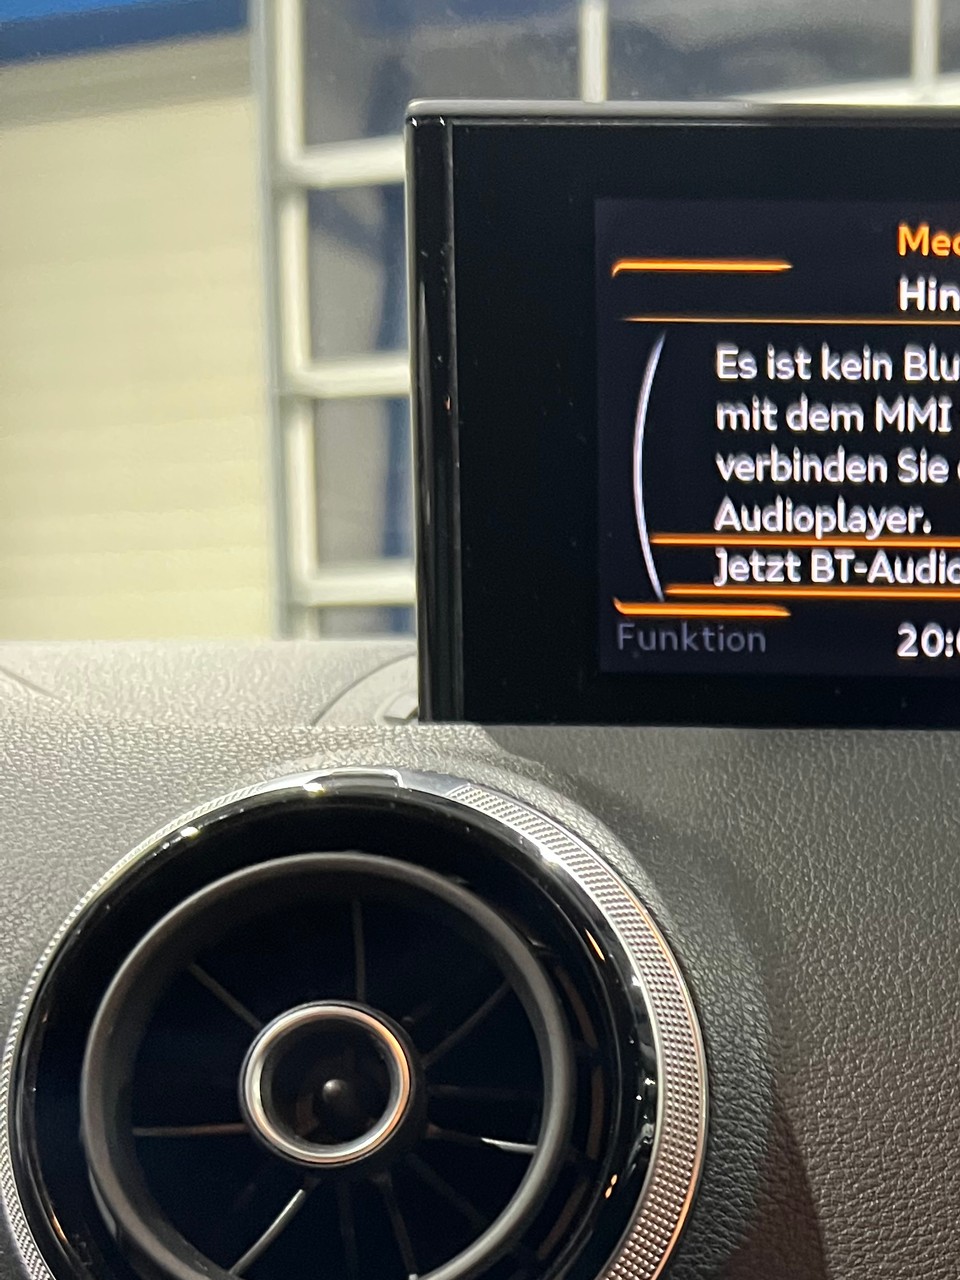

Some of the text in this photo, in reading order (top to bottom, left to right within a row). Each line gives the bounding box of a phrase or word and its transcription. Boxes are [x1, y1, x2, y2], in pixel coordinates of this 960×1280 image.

[716, 343, 758, 380] Es
[766, 344, 811, 382] ist
[821, 344, 892, 382] kein
[716, 394, 778, 432] mit
[786, 394, 863, 432] dem
[874, 399, 952, 433] MMI
[716, 448, 888, 484] verbinden
[898, 449, 948, 484] Sie
[714, 496, 932, 539] Audioplayer.
[714, 548, 801, 587] Jetzt
[617, 622, 766, 654] Funktion
